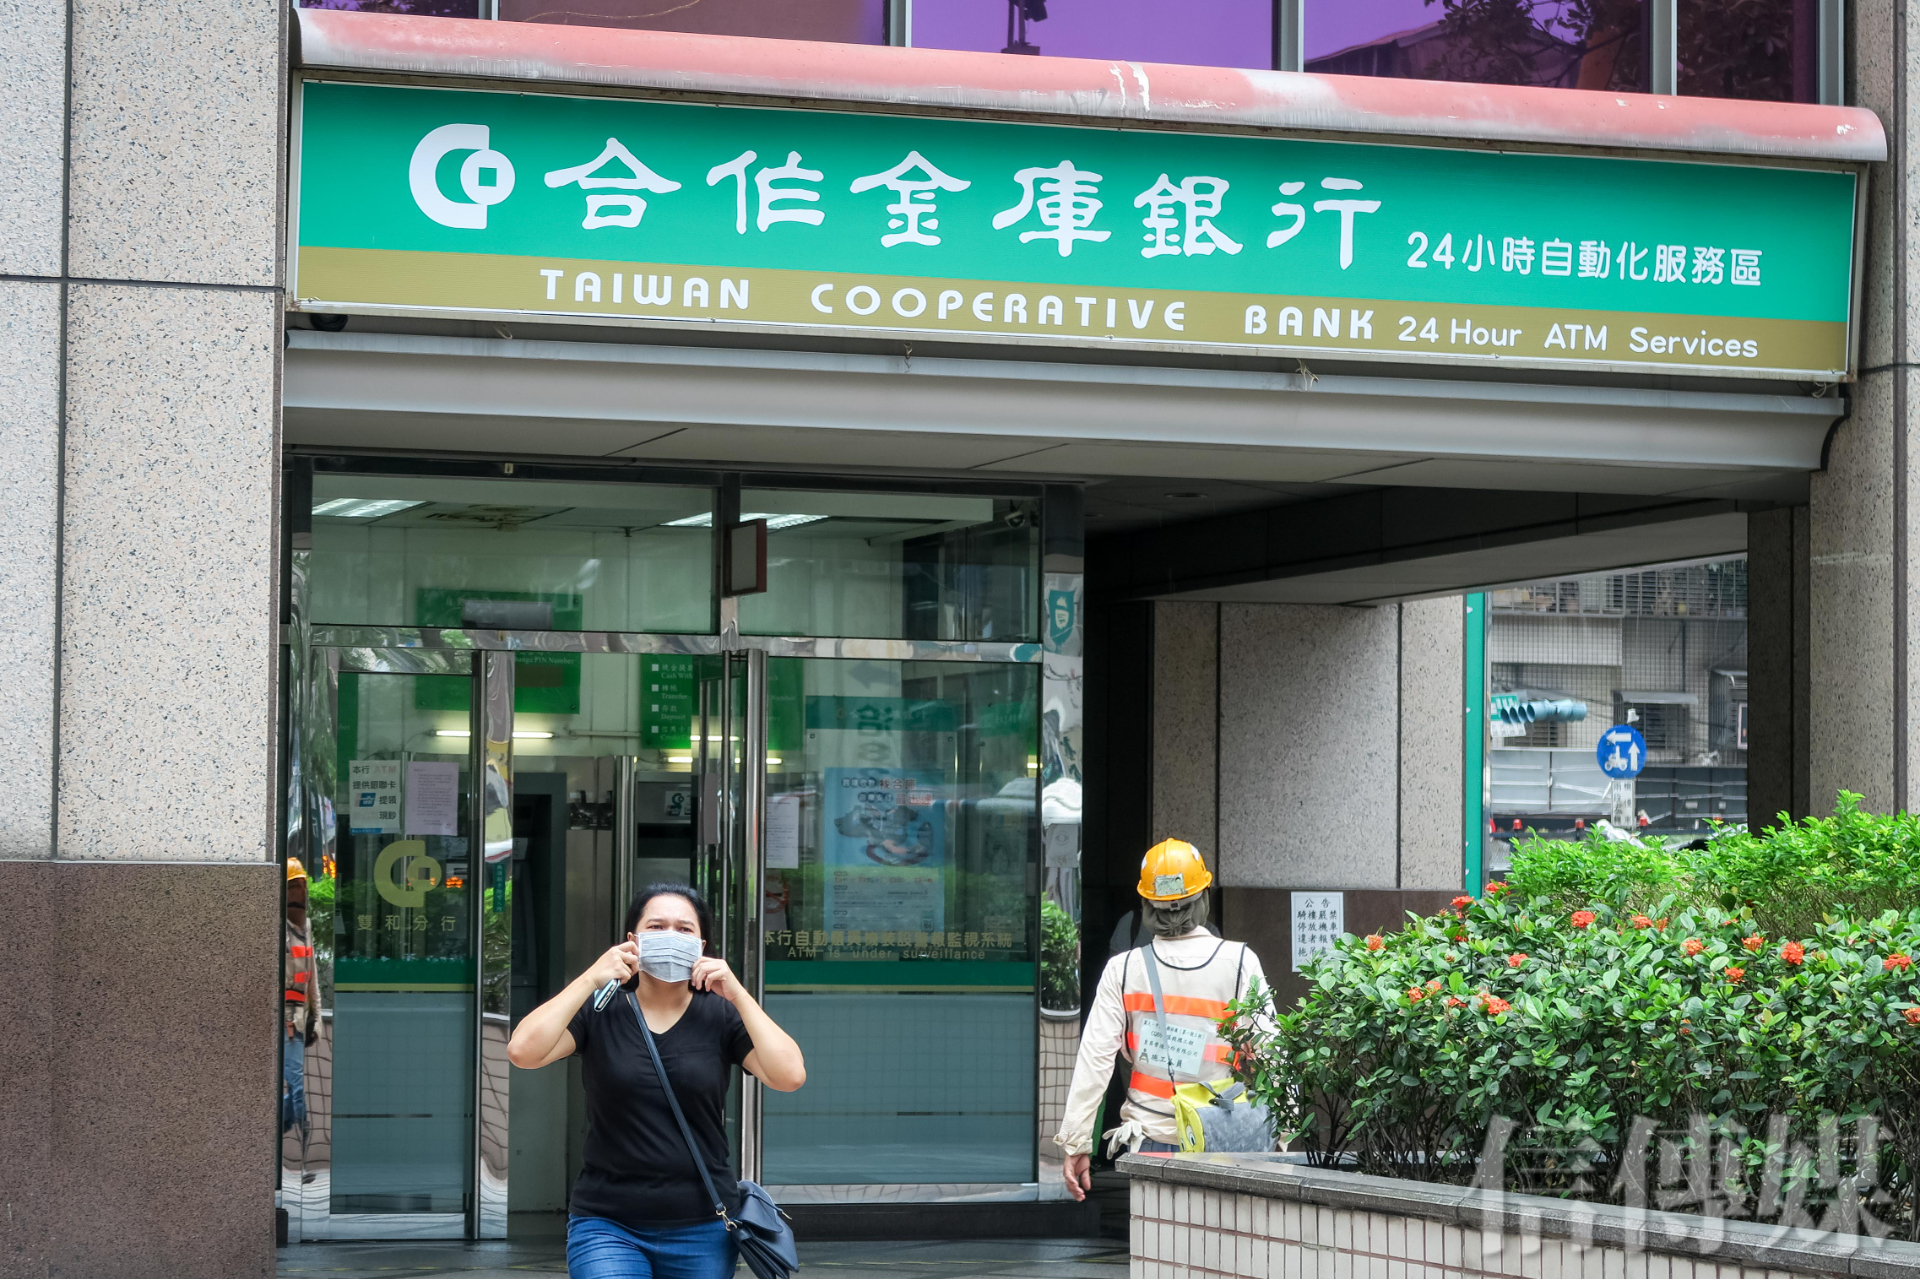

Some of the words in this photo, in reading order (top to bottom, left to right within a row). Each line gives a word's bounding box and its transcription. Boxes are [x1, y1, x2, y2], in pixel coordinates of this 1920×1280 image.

[544, 137, 1382, 271] 合作金庫銀行
[1406, 230, 1764, 288] 24小時自動化服務區
[540, 268, 750, 311] TAIWAN
[810, 282, 1186, 333] COOPERATIVE
[1244, 304, 1375, 341] BANK
[1398, 315, 1440, 344] 24
[1450, 318, 1523, 348] Hour
[1544, 323, 1609, 352] ATM
[1629, 325, 1759, 359] Services
[357, 914, 457, 932] 雙和分行
[1304, 897, 1331, 909] 公告
[787, 948, 817, 959] ATM
[829, 947, 841, 959] is
[852, 948, 893, 960] under
[902, 948, 986, 961] surveillance
